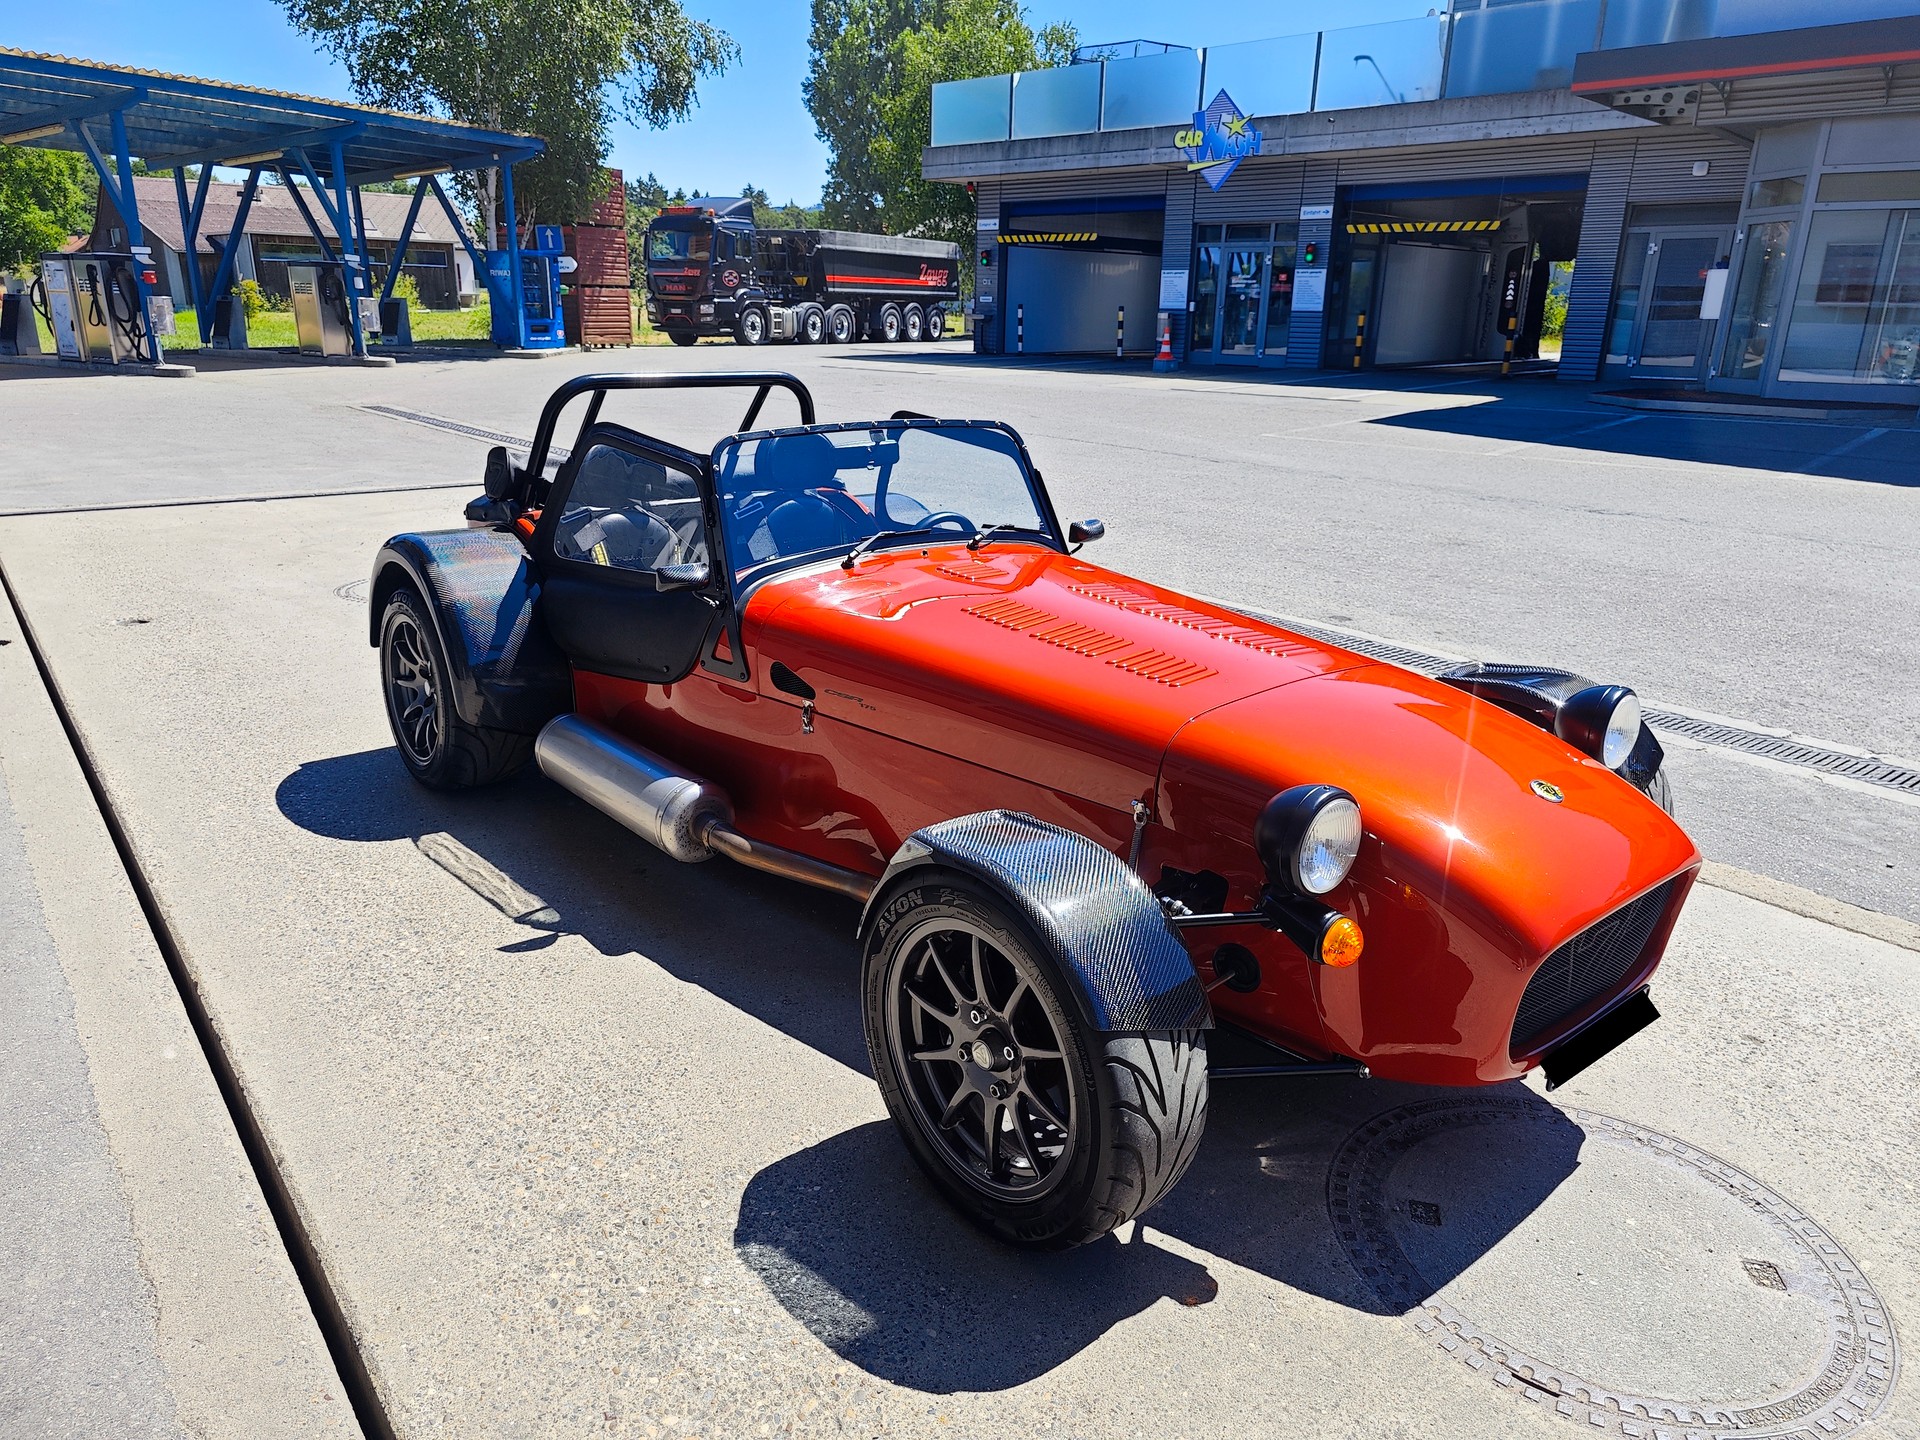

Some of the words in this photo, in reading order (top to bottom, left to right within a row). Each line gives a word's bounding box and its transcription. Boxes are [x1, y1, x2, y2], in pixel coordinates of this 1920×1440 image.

[1174, 130, 1204, 149] CAR
[1193, 111, 1262, 163] WASH
[878, 889, 924, 938] AVON
